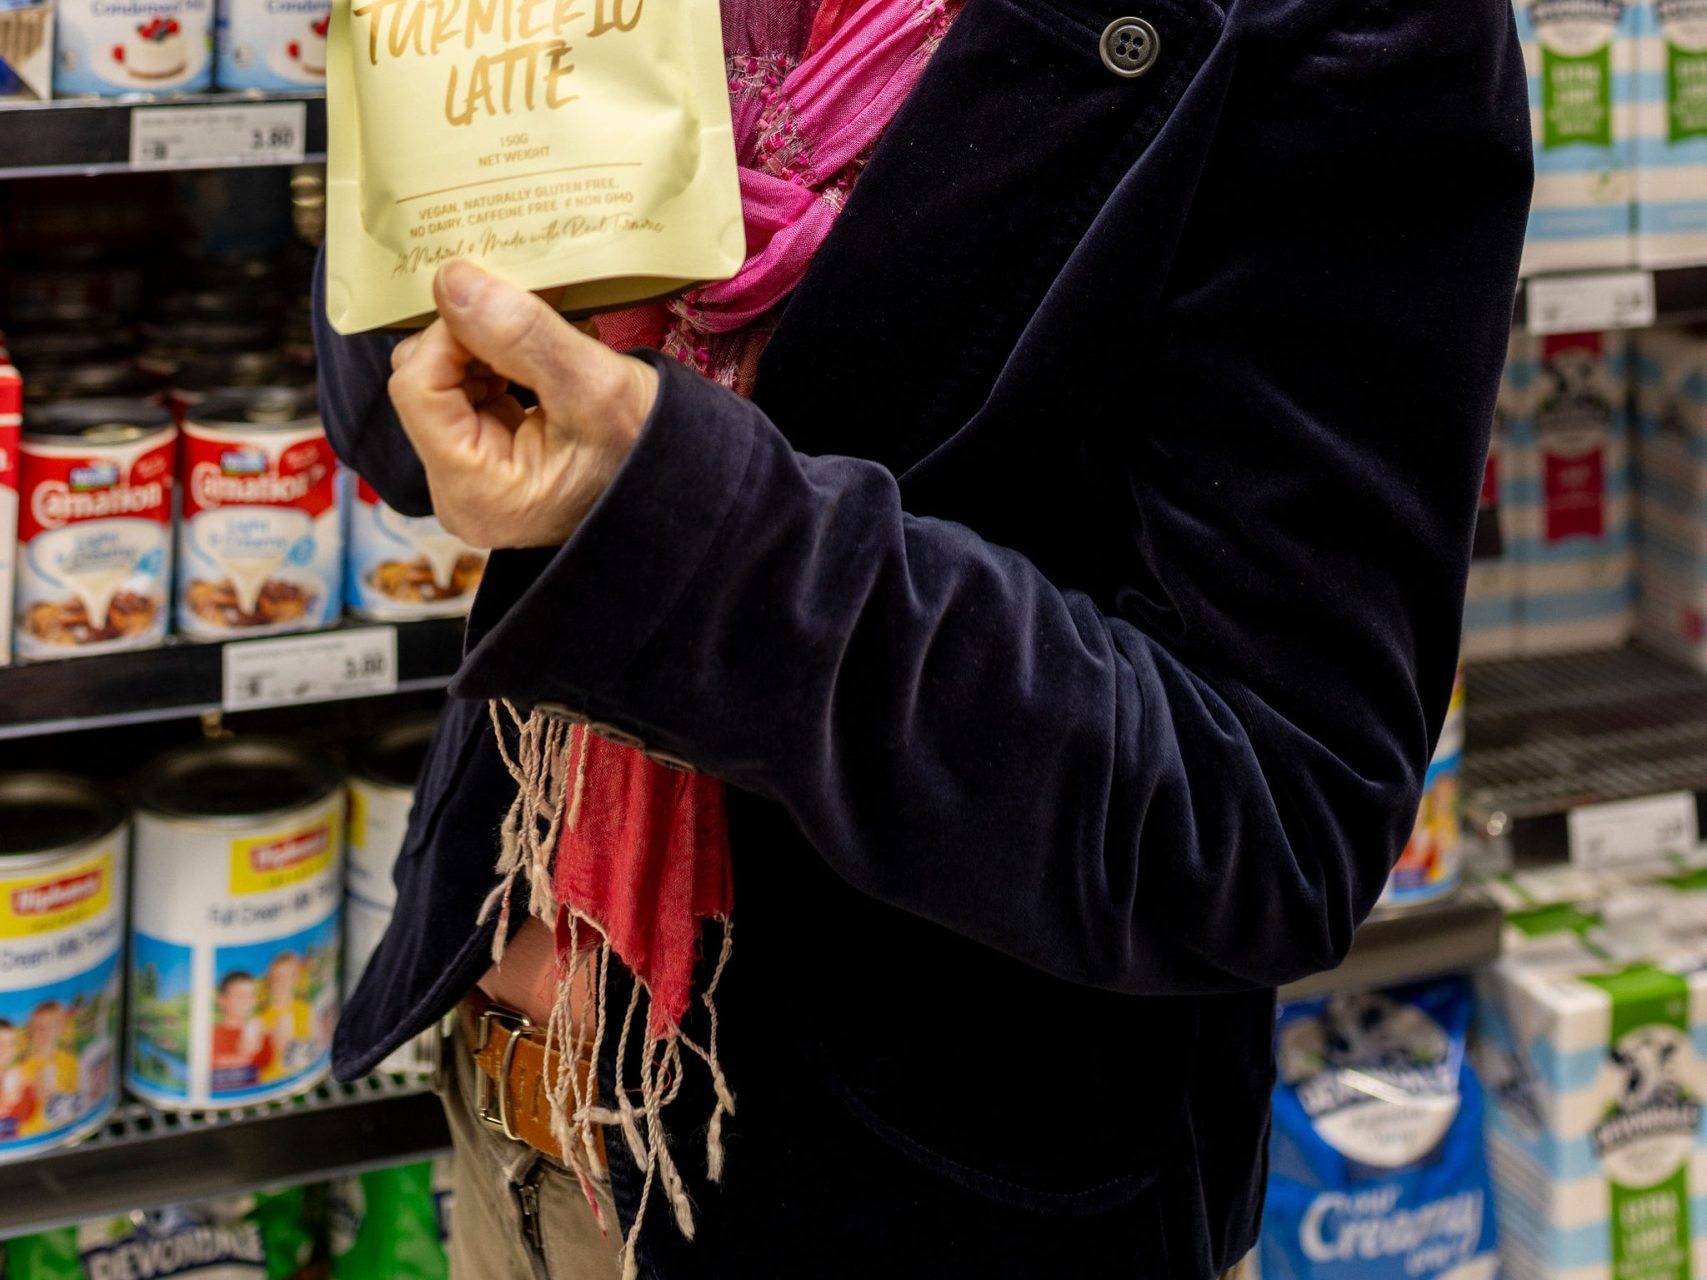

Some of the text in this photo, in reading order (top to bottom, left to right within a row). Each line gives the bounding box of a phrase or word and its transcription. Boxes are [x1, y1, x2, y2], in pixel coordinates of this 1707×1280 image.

[445, 39, 580, 127] LATTE
[478, 144, 551, 168] NET WEIGHT
[409, 225, 426, 239] NO
[467, 205, 526, 226] CAFFEINE
[527, 199, 558, 215] FREE
[575, 193, 602, 207] NON
[604, 190, 634, 204] GMO
[463, 188, 532, 210] NATURALLY
[535, 180, 583, 198] GLUTEN
[31, 480, 163, 529] Carnation
